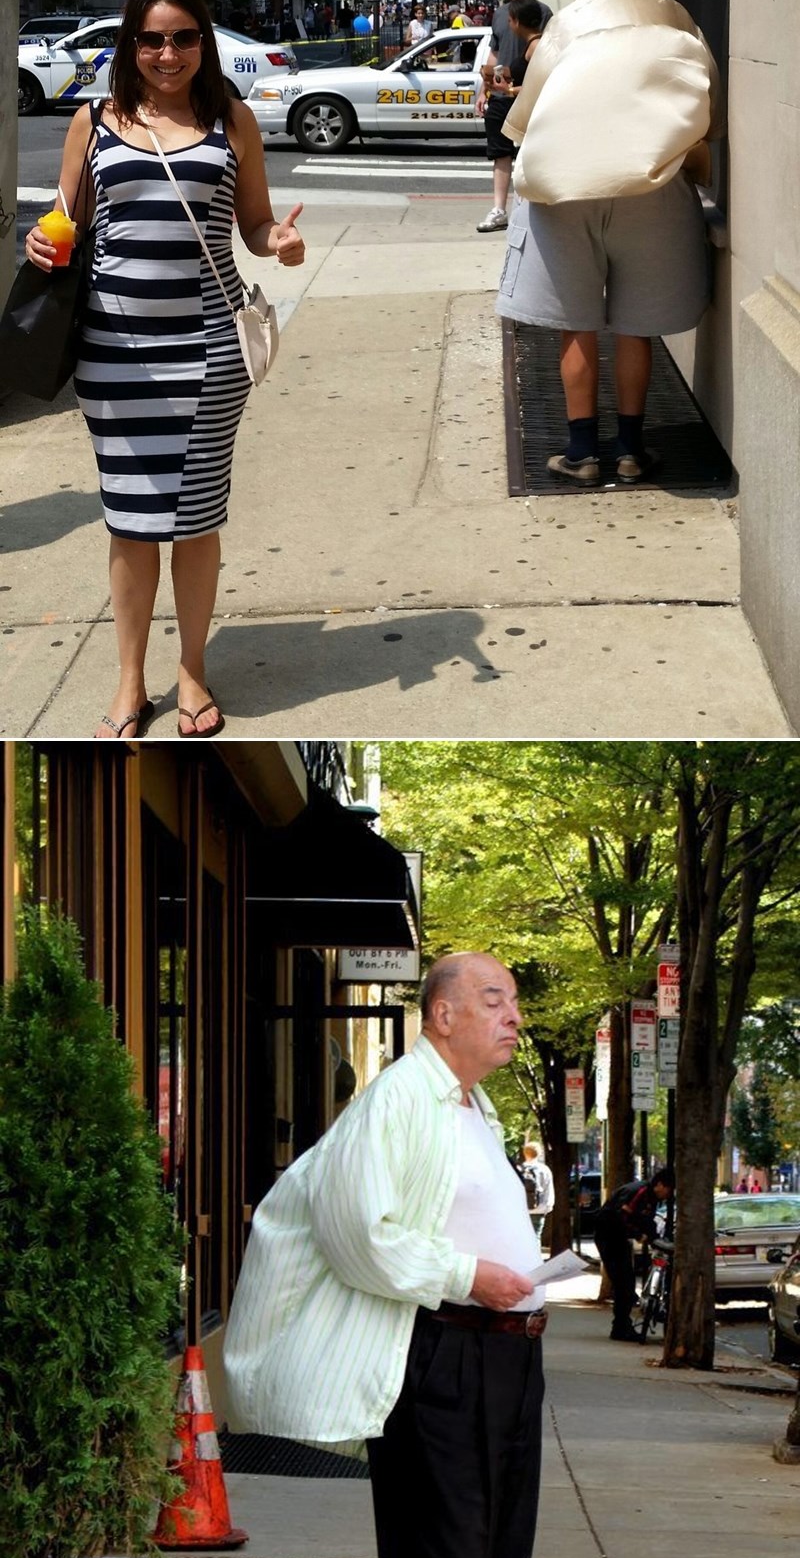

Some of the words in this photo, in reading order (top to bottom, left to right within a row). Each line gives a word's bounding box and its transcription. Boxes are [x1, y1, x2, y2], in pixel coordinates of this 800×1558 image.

[77, 66, 94, 74] POLICE
[234, 63, 257, 73] 911
[284, 85, 303, 95] P-950
[378, 89, 420, 104] 215
[426, 90, 475, 104] GET
[349, 949, 366, 958] OUT
[356, 961, 402, 969] Mon.-Fri.
[664, 997, 680, 1007] TIM
